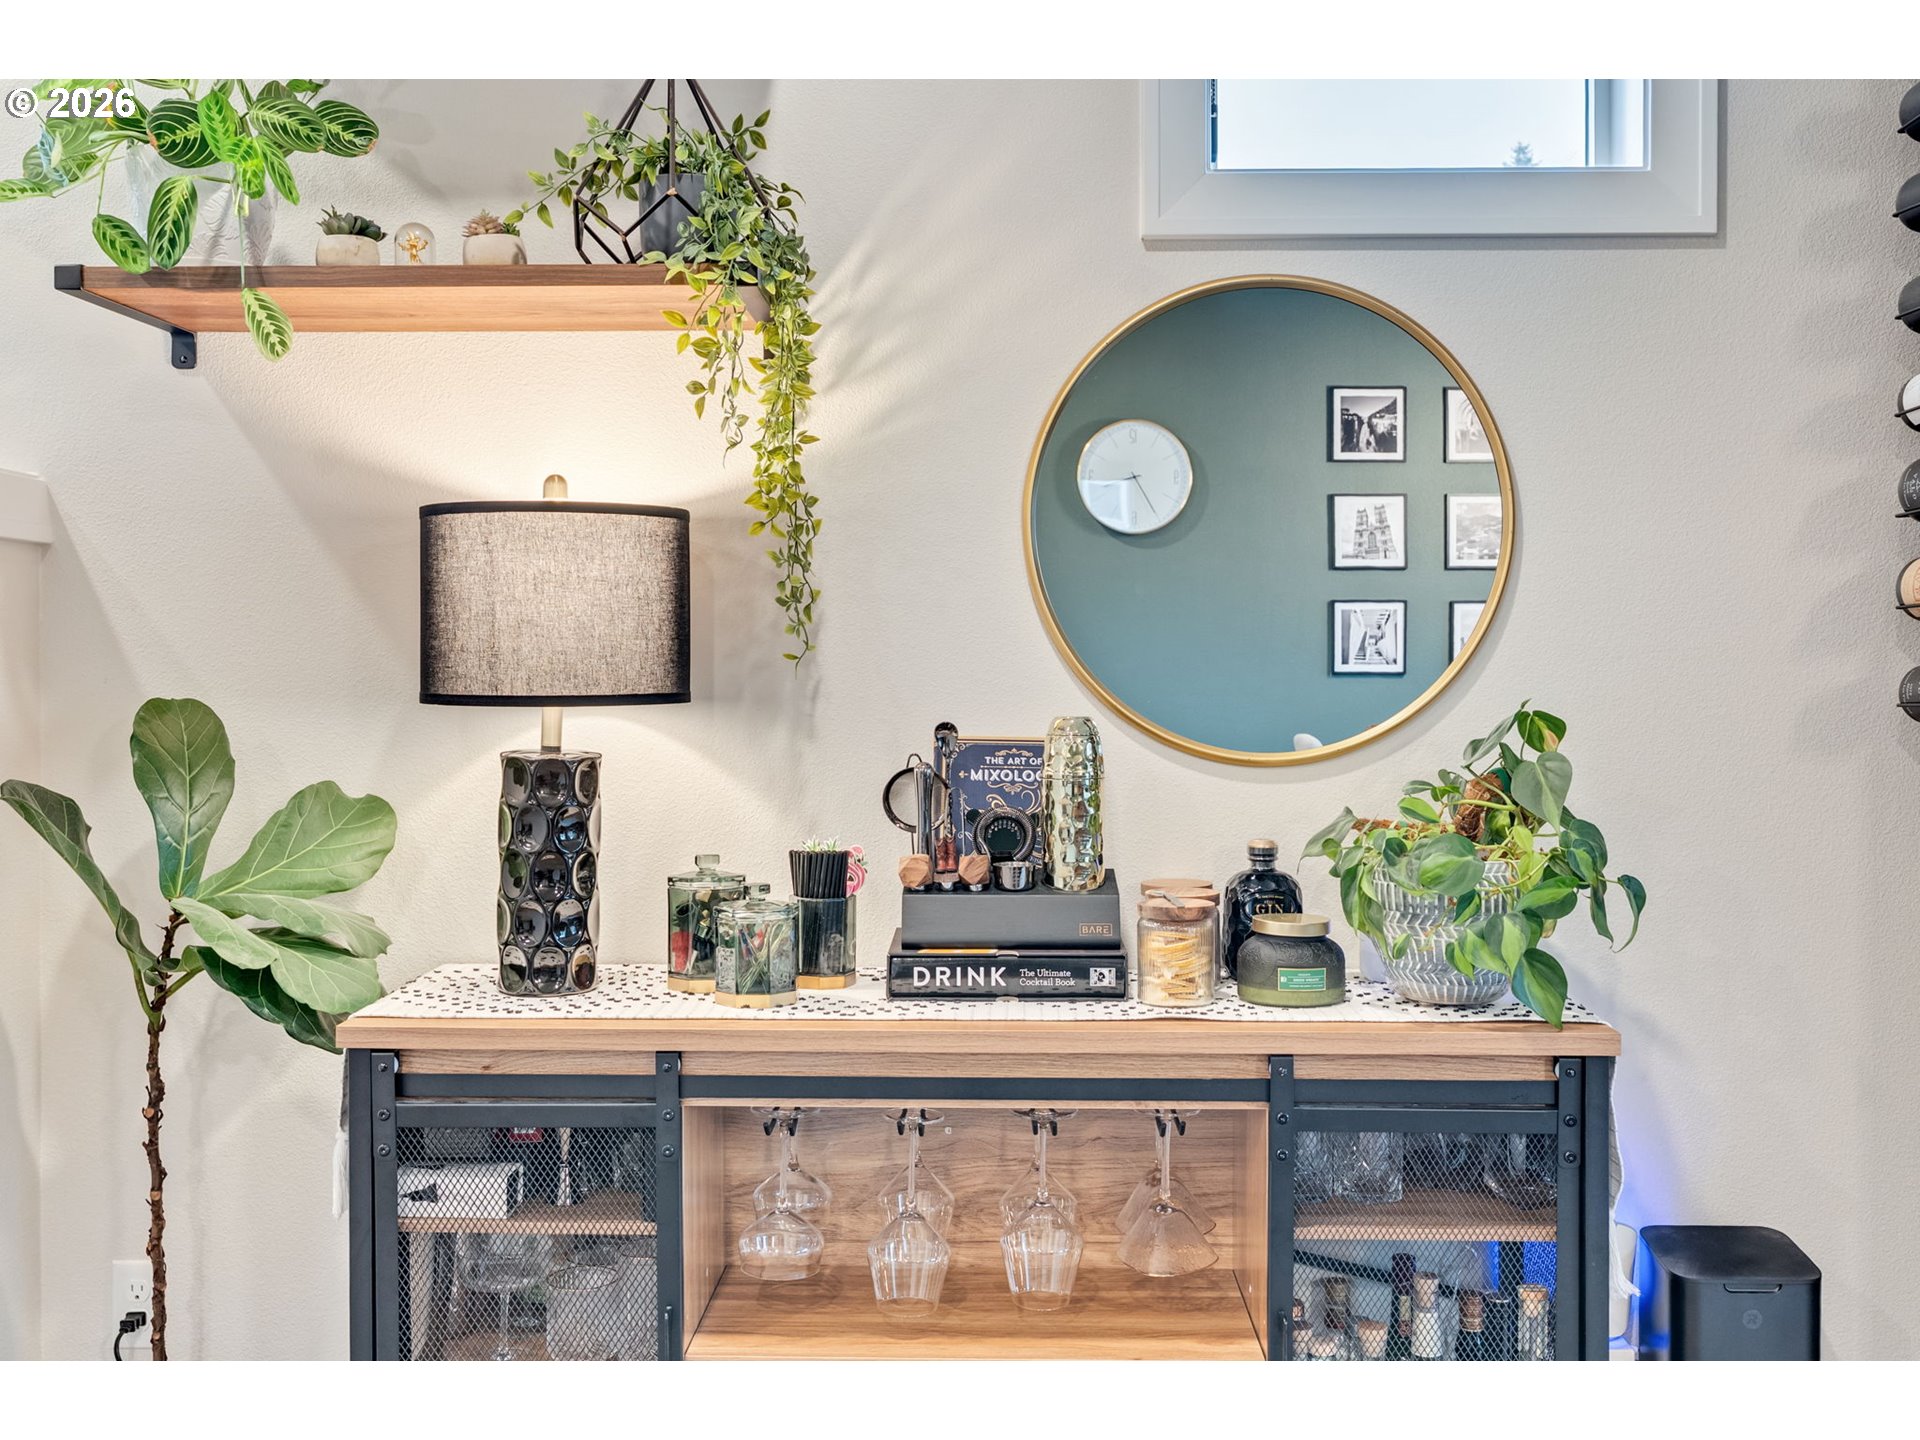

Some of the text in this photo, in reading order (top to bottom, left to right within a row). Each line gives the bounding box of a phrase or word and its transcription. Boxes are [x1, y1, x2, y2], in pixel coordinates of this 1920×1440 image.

[984, 756, 1043, 766] THE ART OF
[970, 768, 1042, 783] MIXOLO
[1255, 903, 1284, 914] GIN
[1081, 925, 1110, 934] BARE
[913, 966, 1007, 987] DRINK
[1019, 968, 1072, 977] The Ultimate
[1019, 978, 1076, 987] Cocktail Book
